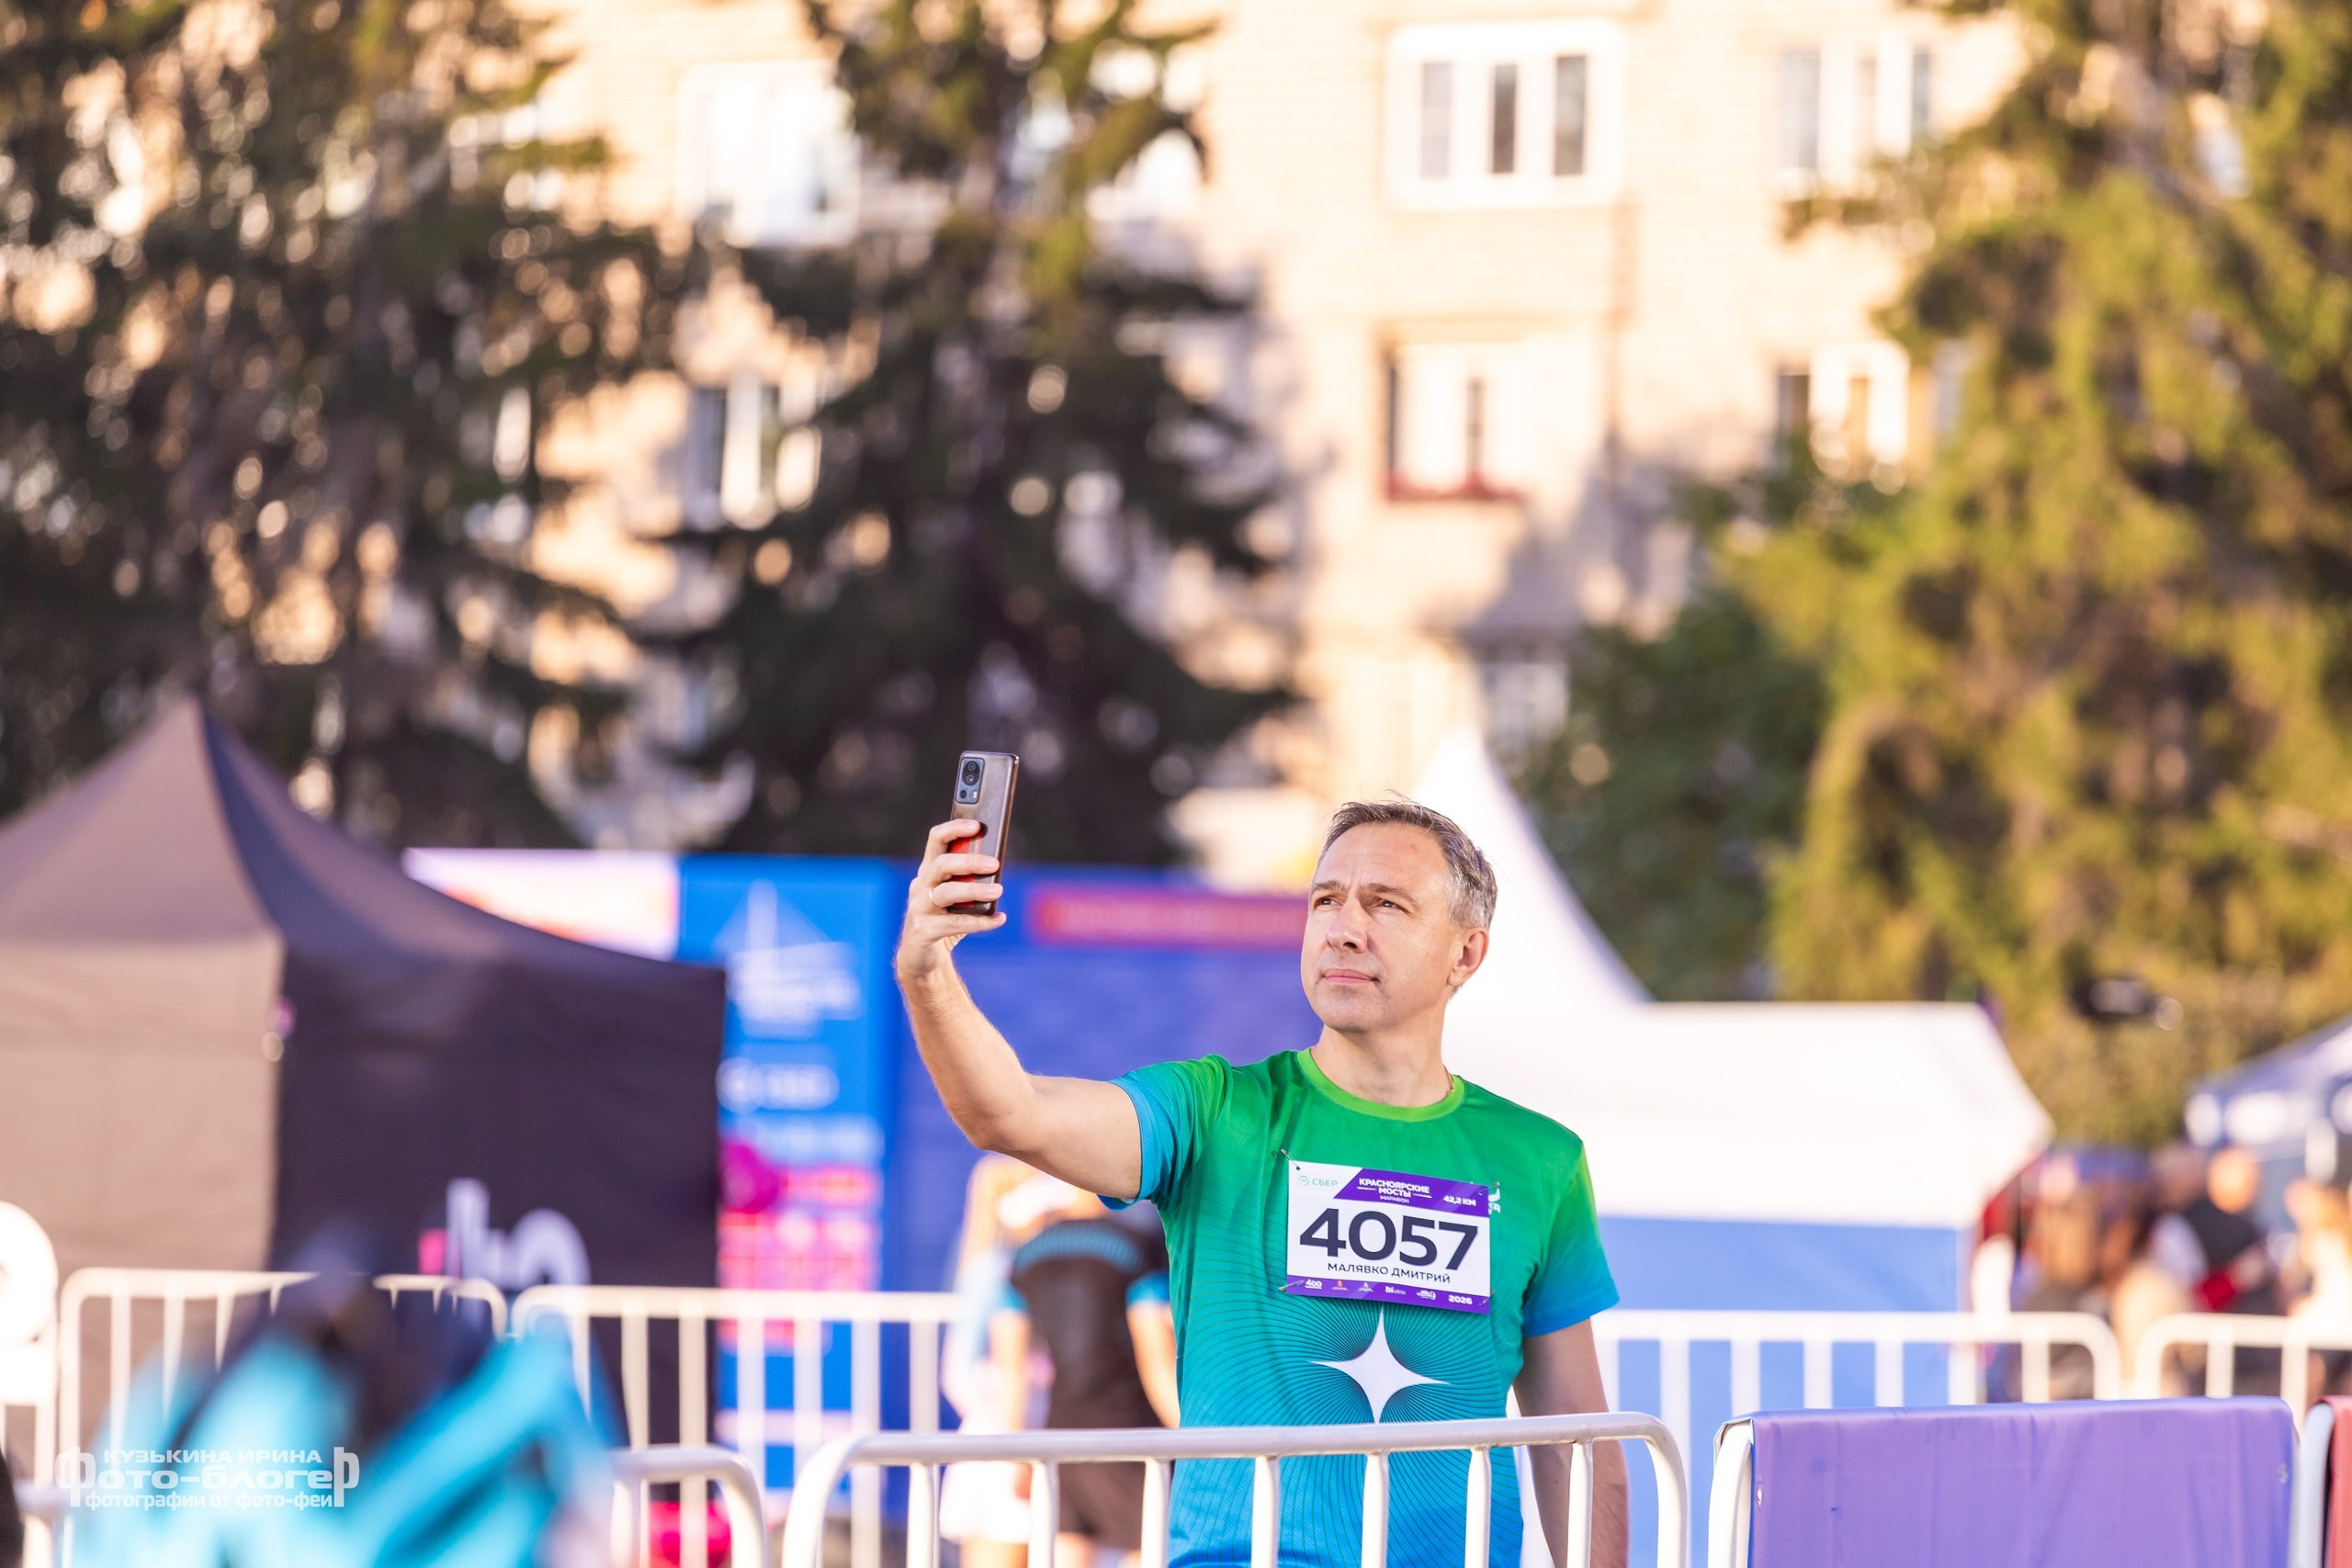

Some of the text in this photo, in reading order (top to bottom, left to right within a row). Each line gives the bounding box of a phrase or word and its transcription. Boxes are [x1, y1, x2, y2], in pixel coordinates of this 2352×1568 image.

[1312, 1178, 1338, 1187] СБЕР
[1359, 1178, 1430, 1194] КРАСНОЯРСКИЕ
[1378, 1187, 1411, 1198] МОСТЫ
[1380, 1195, 1409, 1204] МАРАФОН
[1443, 1195, 1476, 1207] 42,2 КМ
[1299, 1207, 1478, 1271] 4057
[1328, 1262, 1451, 1284] МАЛЯВКО ДМИТРИЙ
[1448, 1294, 1473, 1305] 2026
